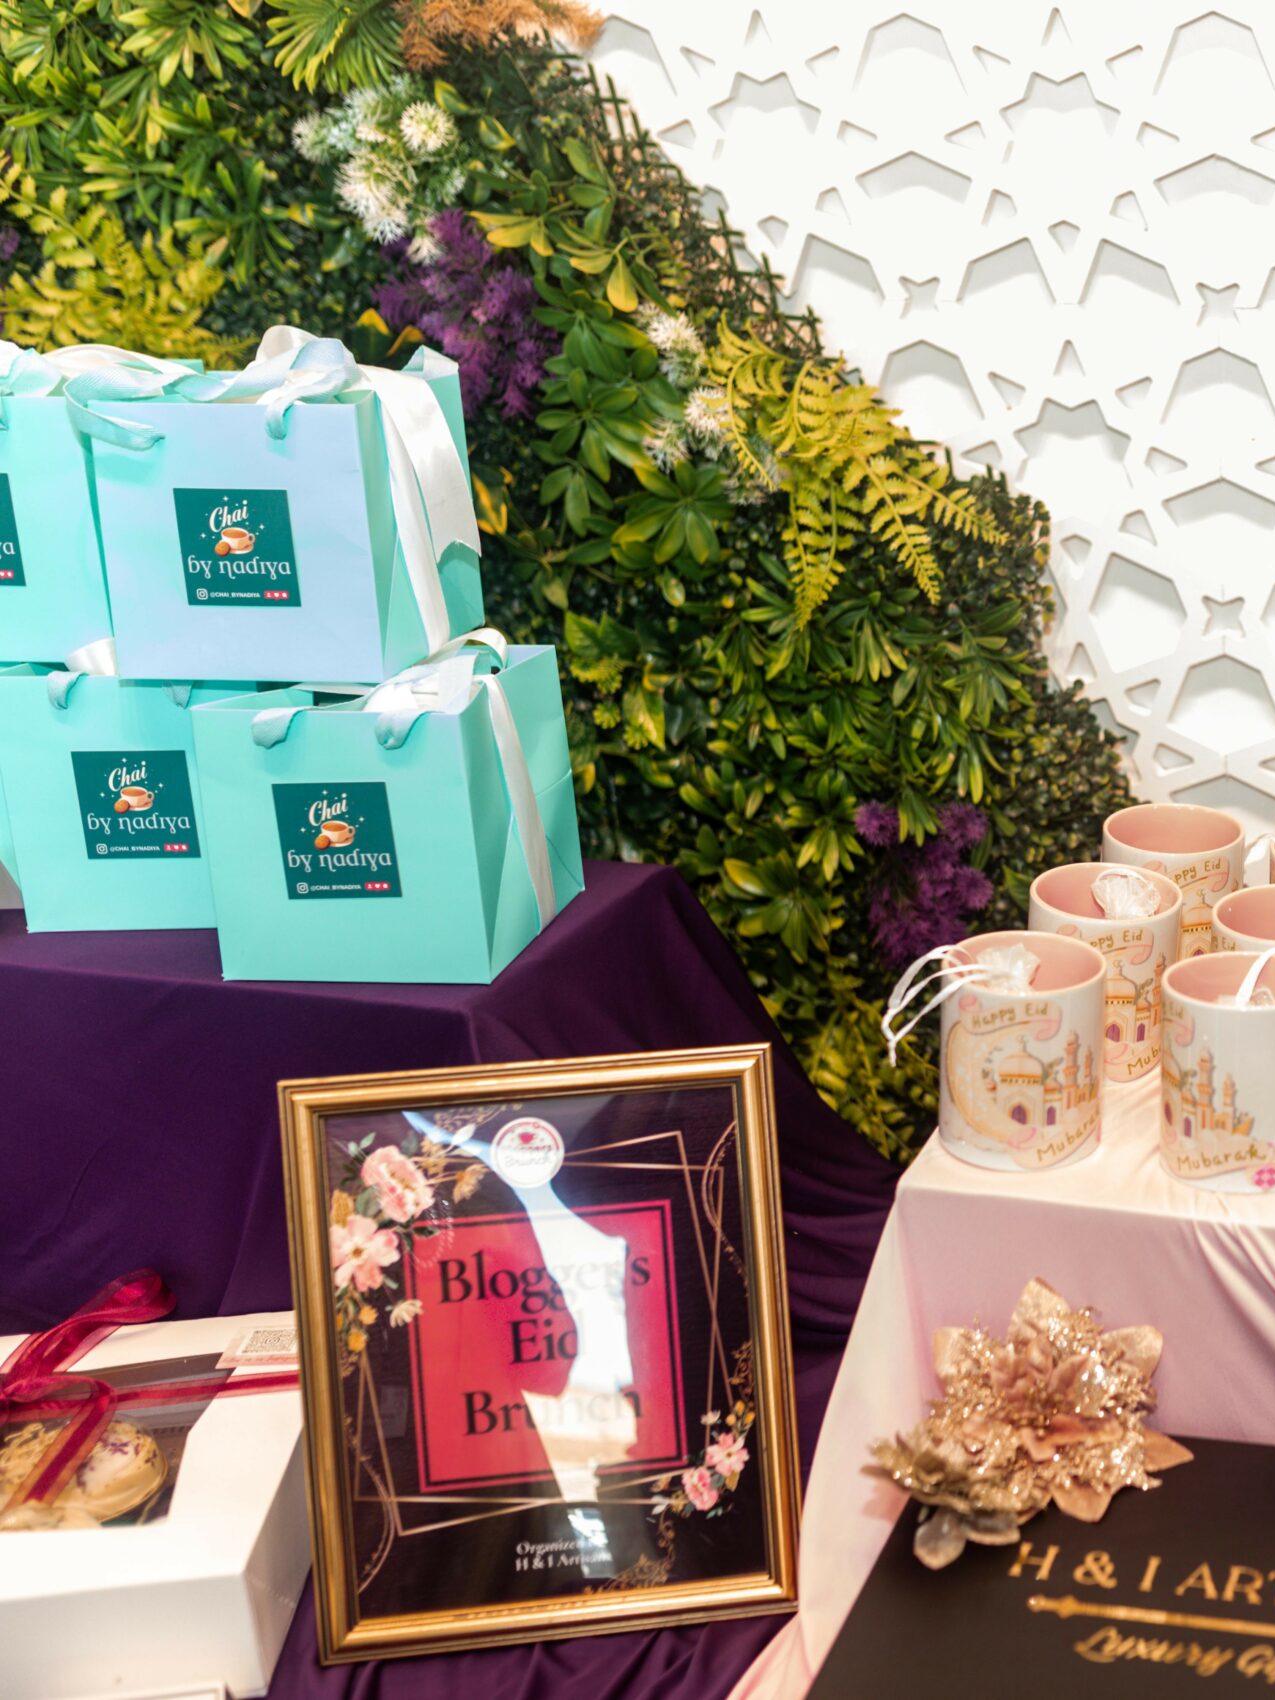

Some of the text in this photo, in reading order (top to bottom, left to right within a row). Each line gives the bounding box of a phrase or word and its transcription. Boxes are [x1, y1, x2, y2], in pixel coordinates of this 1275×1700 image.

[208, 499, 249, 533] Chai
[187, 555, 292, 580] by nadiya
[108, 760, 147, 792] Chai
[87, 812, 191, 835] by nadiya
[308, 792, 349, 827] Chai
[287, 848, 392, 873] by nadiya
[1172, 859, 1222, 884] ppy Eid
[1122, 928, 1143, 943] Eid
[971, 1002, 1049, 1029] Happy Eid
[1176, 1143, 1267, 1172] Mubarak
[438, 1250, 651, 1314] Blogger's
[463, 1385, 642, 1437] Brunch
[515, 1557, 529, 1572] H
[532, 1554, 545, 1570] &
[1008, 1542, 1060, 1581] H
[1072, 1550, 1118, 1589] &
[1138, 1556, 1162, 1592] I
[1074, 1626, 1234, 1678] Luxury
